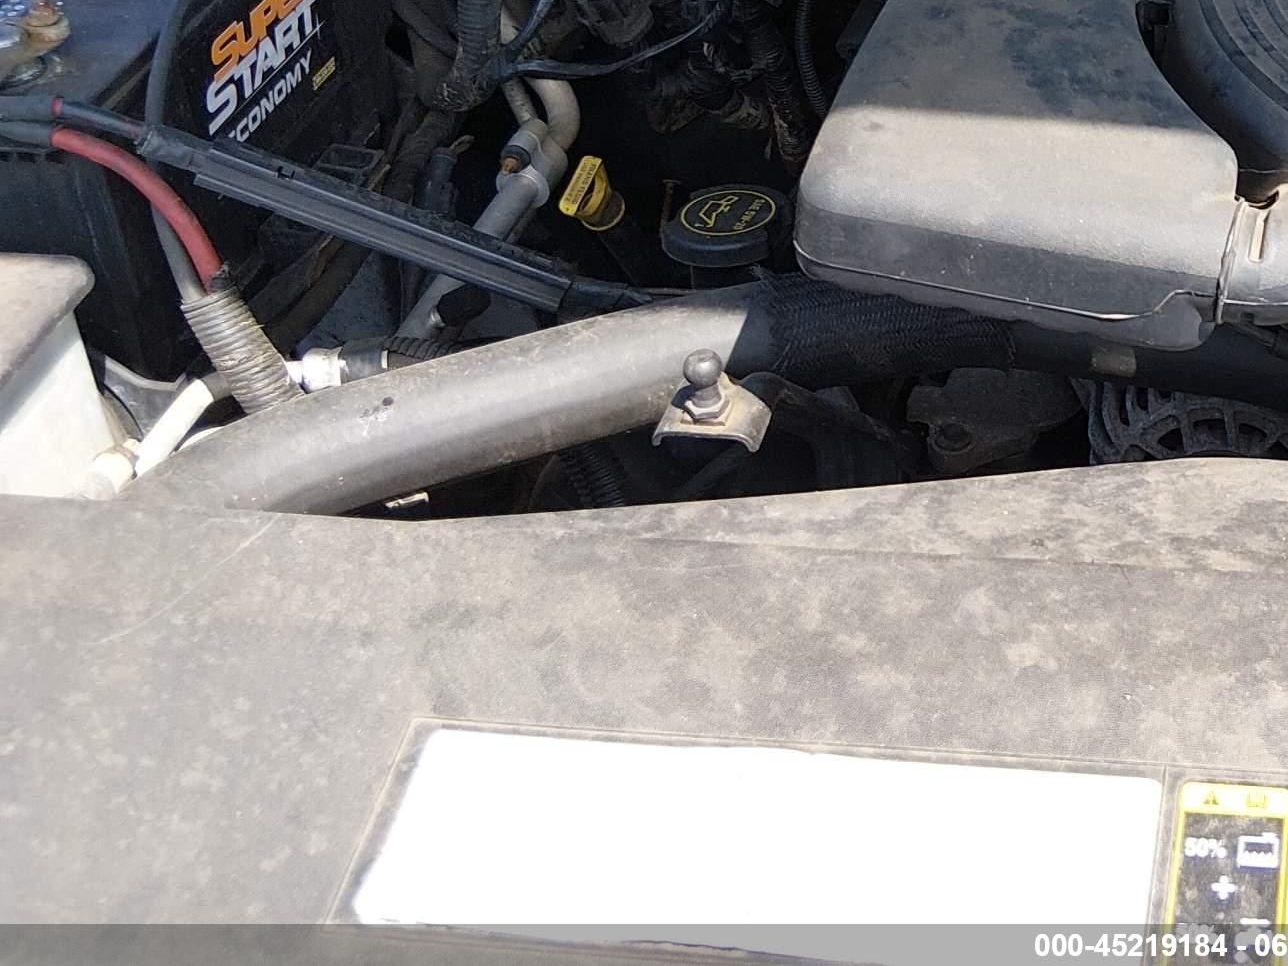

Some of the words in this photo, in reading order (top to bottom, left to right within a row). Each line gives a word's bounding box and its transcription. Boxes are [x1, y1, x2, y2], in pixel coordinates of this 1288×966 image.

[228, 48, 312, 142] CONOMY
[733, 211, 757, 230] 5W-20
[1183, 837, 1228, 859] 50%
